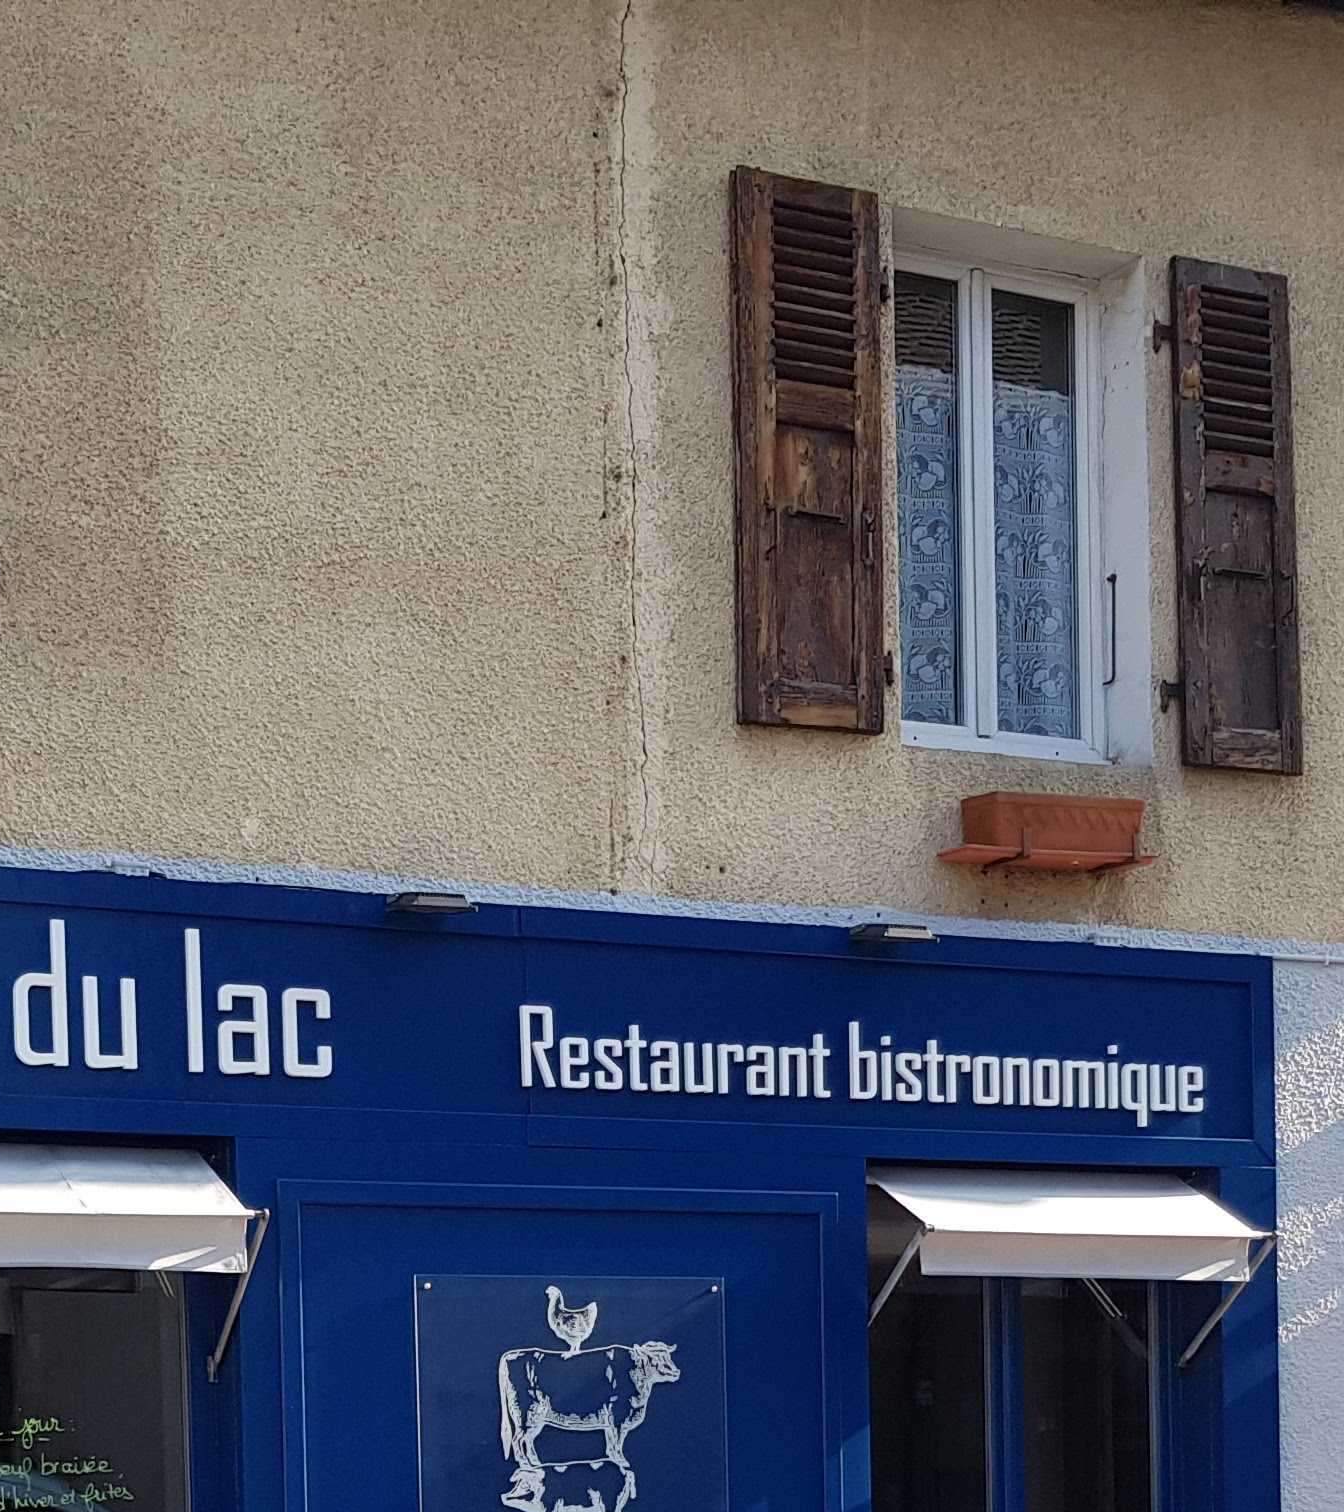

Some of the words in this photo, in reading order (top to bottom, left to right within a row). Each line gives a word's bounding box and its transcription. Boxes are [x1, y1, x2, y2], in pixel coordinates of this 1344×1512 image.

[13, 918, 138, 1070] du
[184, 928, 333, 1078] lac
[519, 1004, 832, 1098] Restaurant
[848, 1021, 1204, 1127] bistronomique
[60, 1488, 76, 1505] et
[81, 1482, 135, 1512] frites
